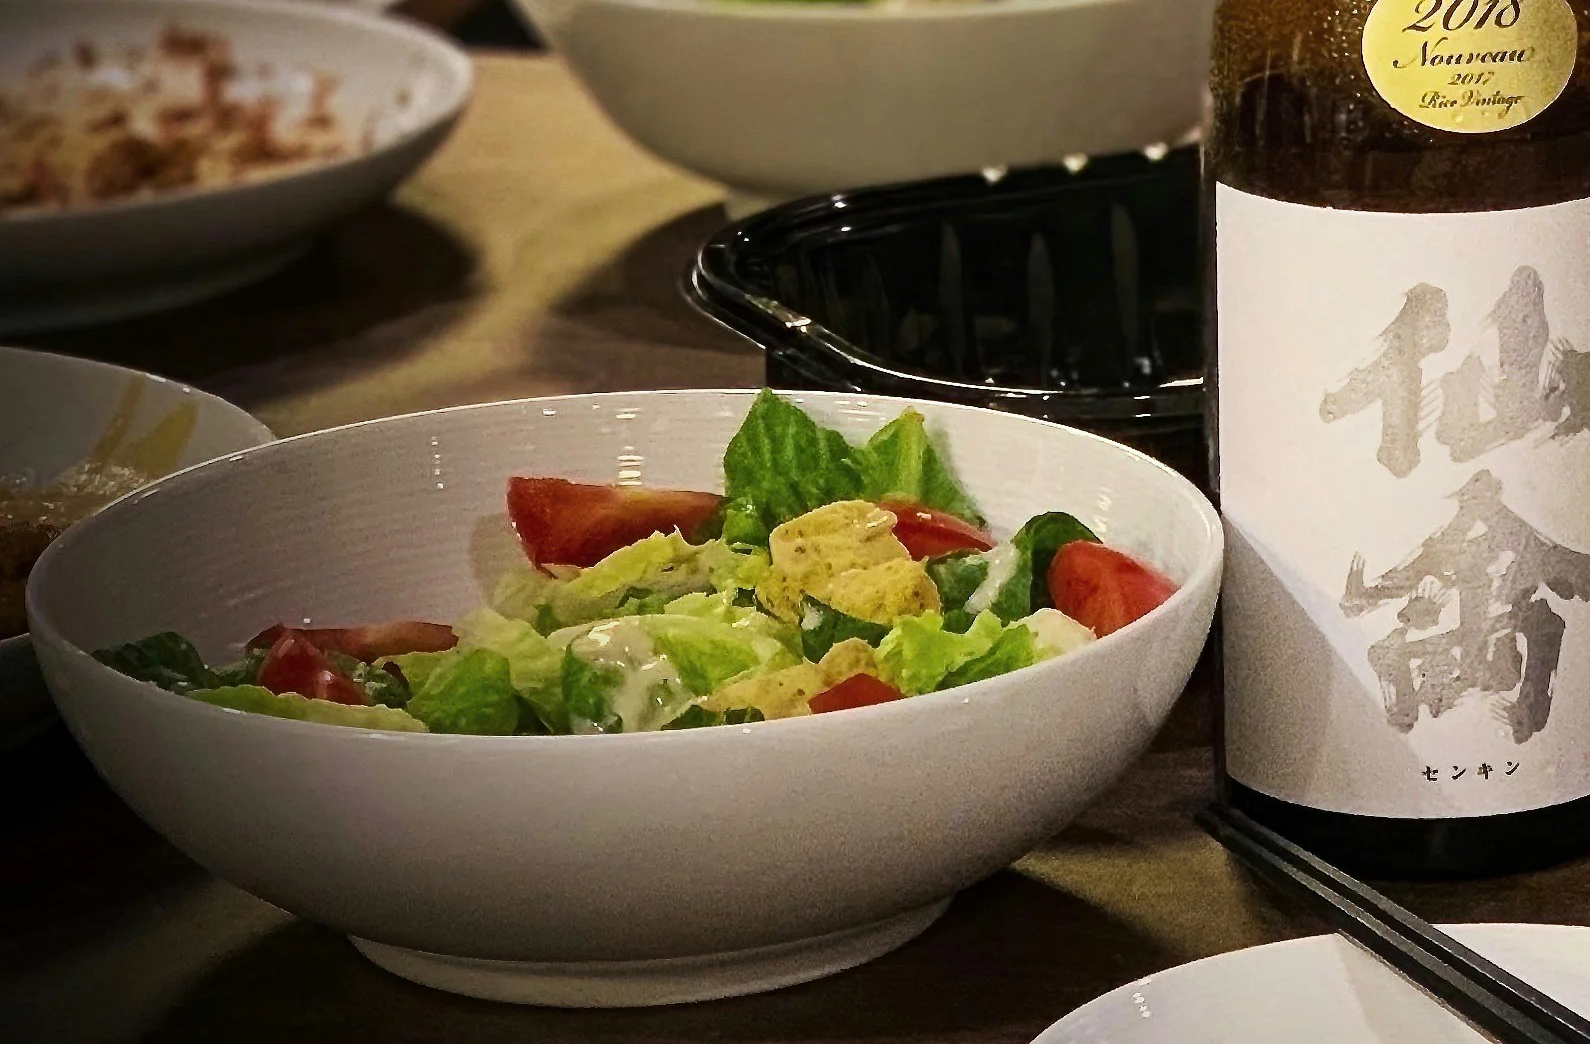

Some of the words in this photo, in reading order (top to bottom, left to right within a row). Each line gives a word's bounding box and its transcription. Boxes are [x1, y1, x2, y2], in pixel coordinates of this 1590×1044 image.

[1392, 36, 1535, 69] Nouveau
[1447, 71, 1495, 86] 2017
[1421, 761, 1520, 782] センキン
